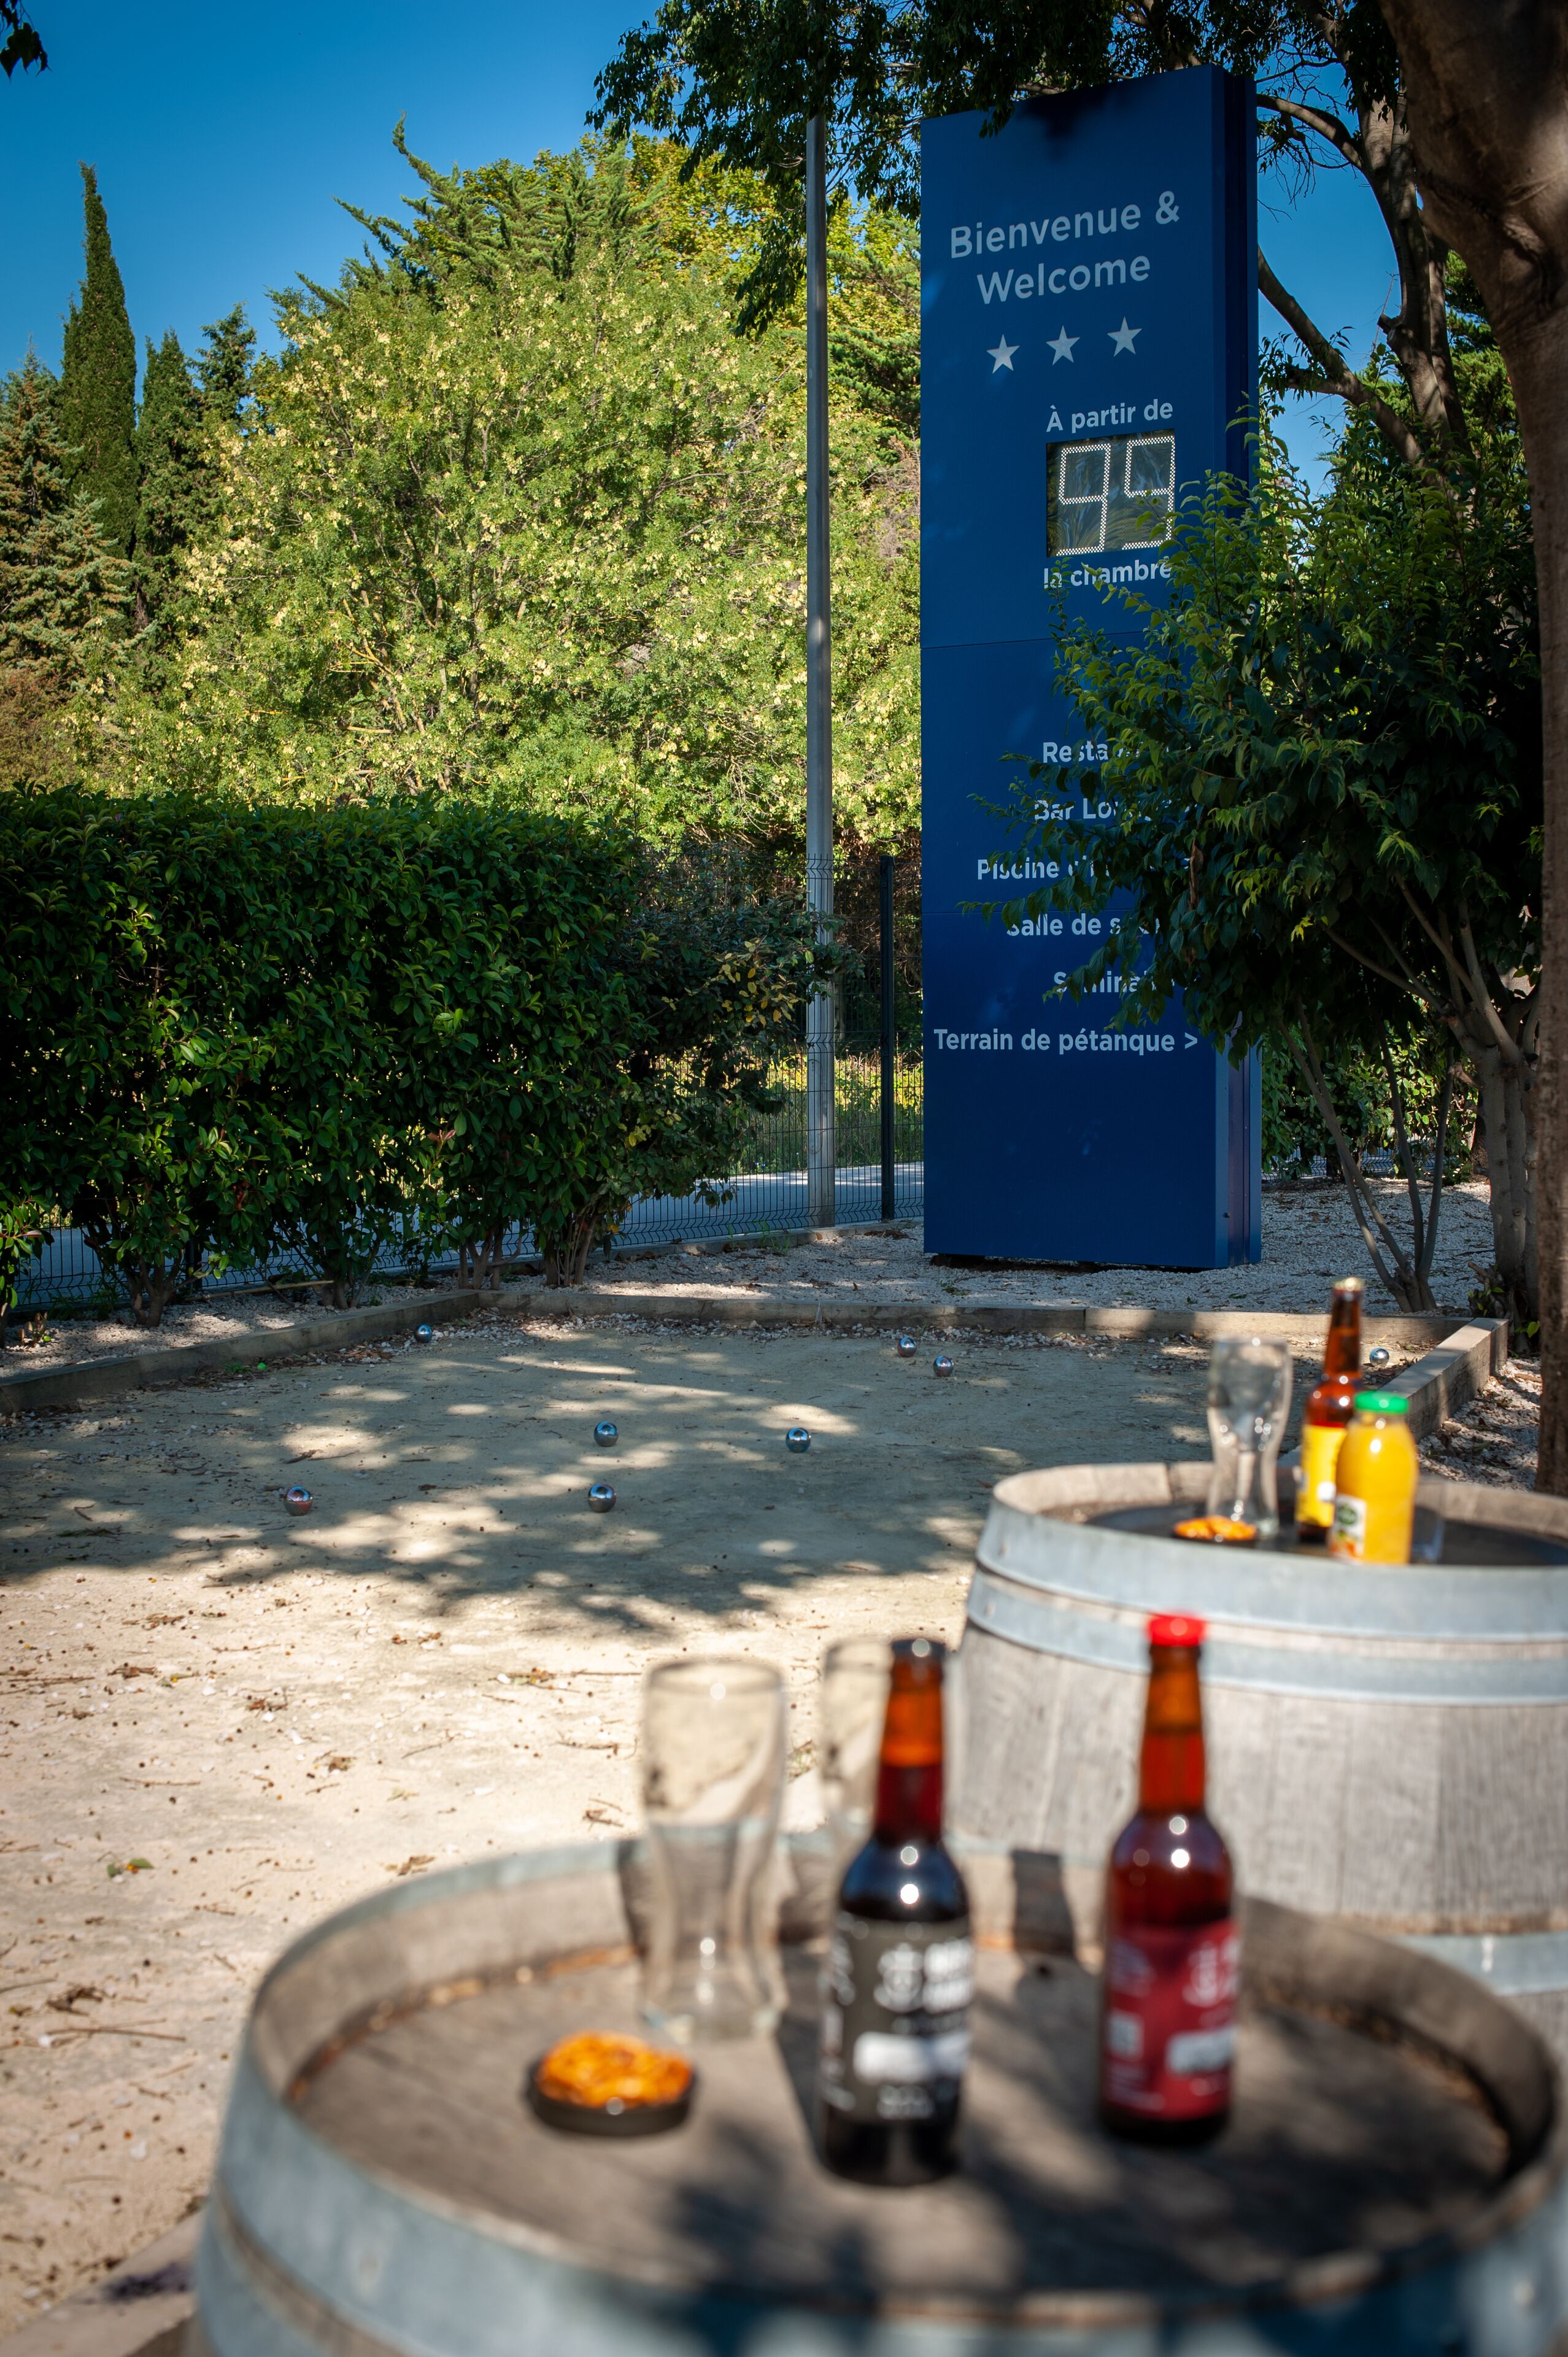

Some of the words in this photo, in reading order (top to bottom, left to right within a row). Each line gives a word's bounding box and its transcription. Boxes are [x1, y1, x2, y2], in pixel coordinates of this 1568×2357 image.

[951, 204, 1141, 258] Bienvenue
[1155, 190, 1180, 225] &
[977, 255, 1149, 304] Welcome
[1046, 404, 1063, 432] À
[1071, 403, 1135, 433] partir
[1143, 399, 1173, 420] de
[1056, 435, 1175, 556] 99
[1044, 568, 1062, 589] la
[1070, 559, 1172, 586] chambre
[1033, 800, 1074, 821] Bar
[978, 857, 1059, 880] Piscine
[1072, 913, 1102, 935] de
[933, 1029, 1013, 1050] Terrain
[1021, 1029, 1050, 1050] de
[1059, 1028, 1175, 1056] pétanque
